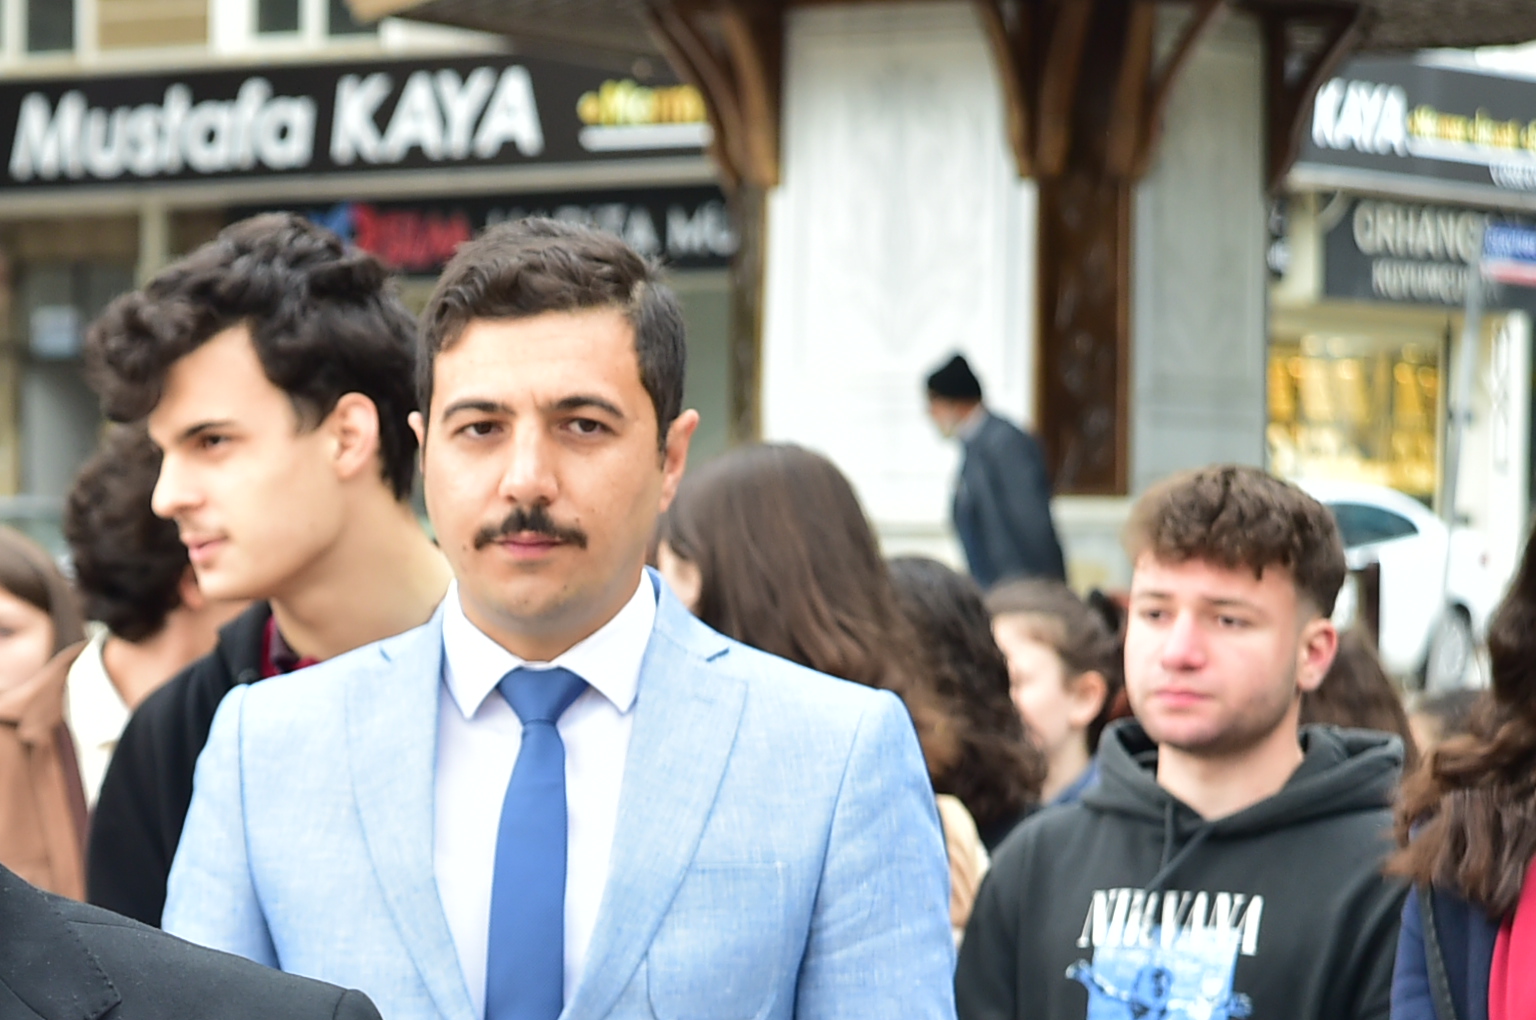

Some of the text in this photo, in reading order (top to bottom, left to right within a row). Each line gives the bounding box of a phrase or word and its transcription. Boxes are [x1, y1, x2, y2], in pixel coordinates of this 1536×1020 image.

[8, 77, 318, 181] Mustafa
[329, 64, 545, 166] KAYA
[1313, 77, 1408, 157] KAYA
[1076, 887, 1263, 956] NIRVANA
